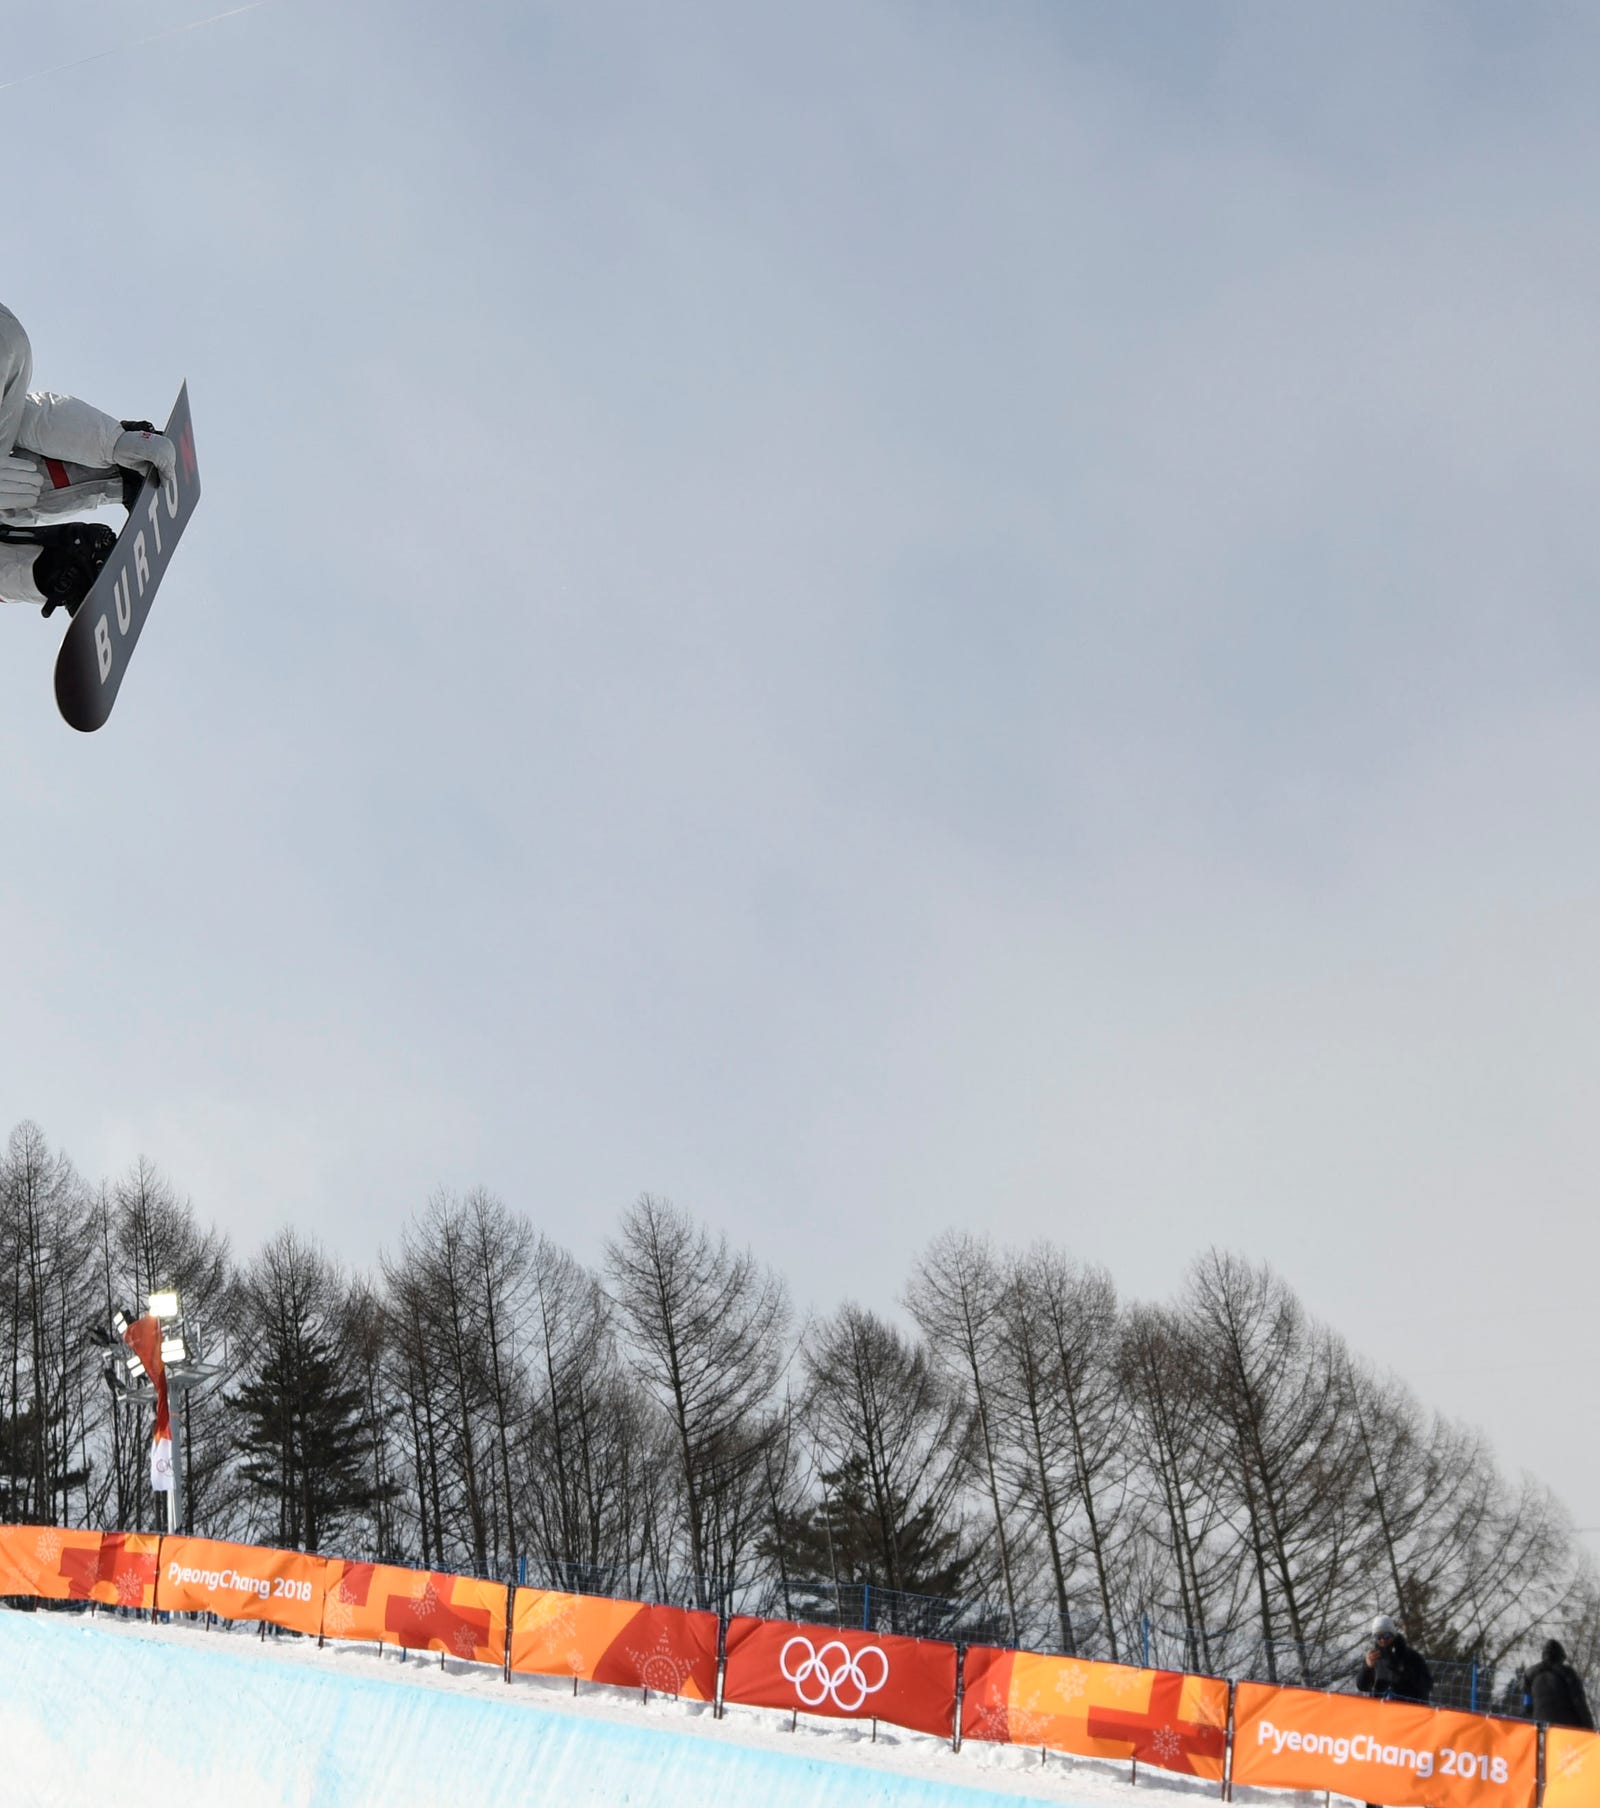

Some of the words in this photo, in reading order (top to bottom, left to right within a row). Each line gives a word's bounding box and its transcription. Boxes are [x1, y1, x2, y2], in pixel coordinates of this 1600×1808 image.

[94, 422, 195, 685] BURTON
[168, 1562, 270, 1599] PyeongChang
[273, 1577, 312, 1601] 2018
[1257, 1721, 1434, 1778] PyeongChang
[1439, 1749, 1508, 1784] 2018
